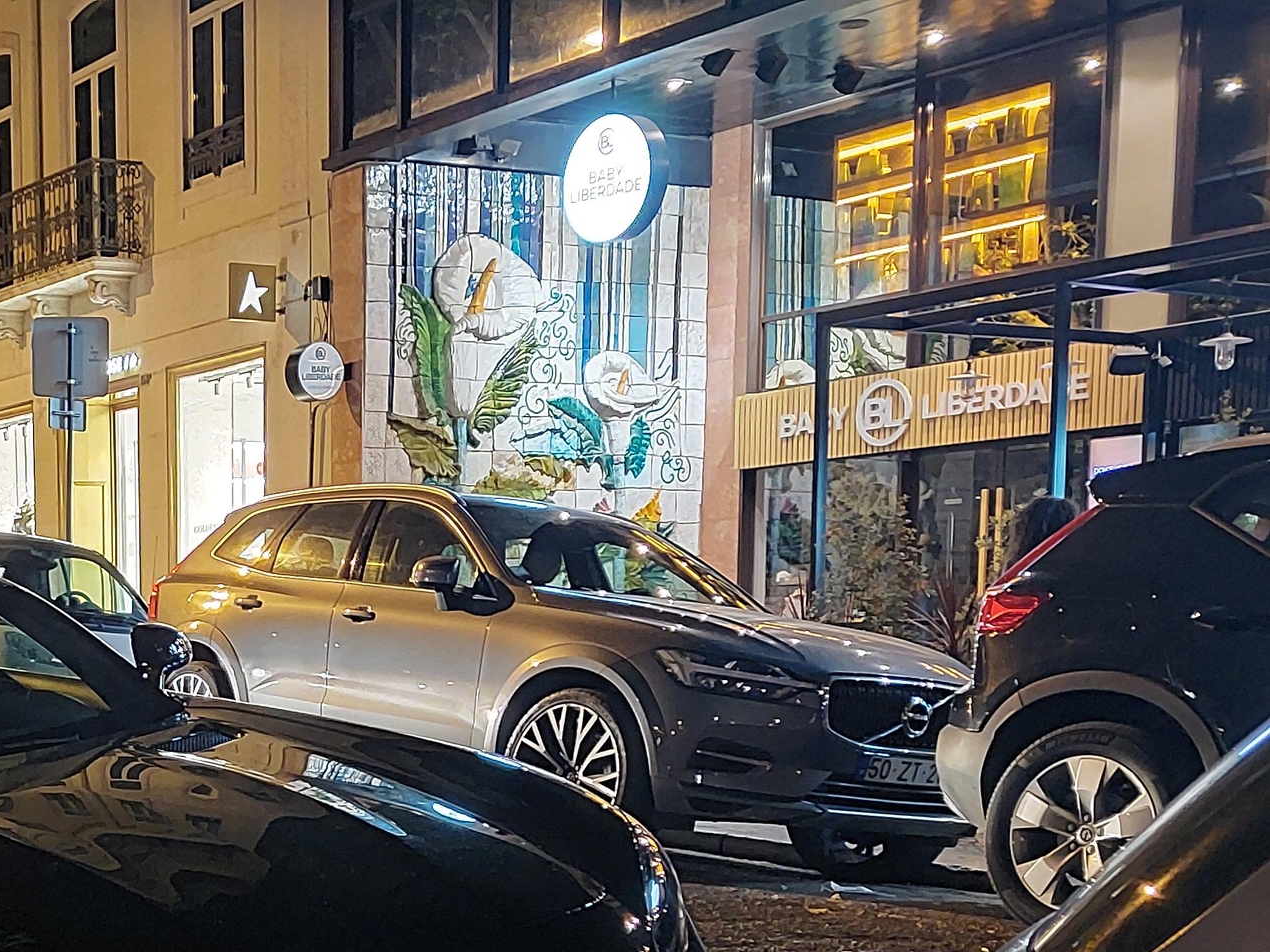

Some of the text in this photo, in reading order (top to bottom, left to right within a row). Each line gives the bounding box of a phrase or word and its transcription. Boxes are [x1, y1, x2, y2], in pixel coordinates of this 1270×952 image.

[589, 165, 623, 184] BABY
[570, 177, 642, 204] LIBERDADE
[779, 405, 848, 439] BAY
